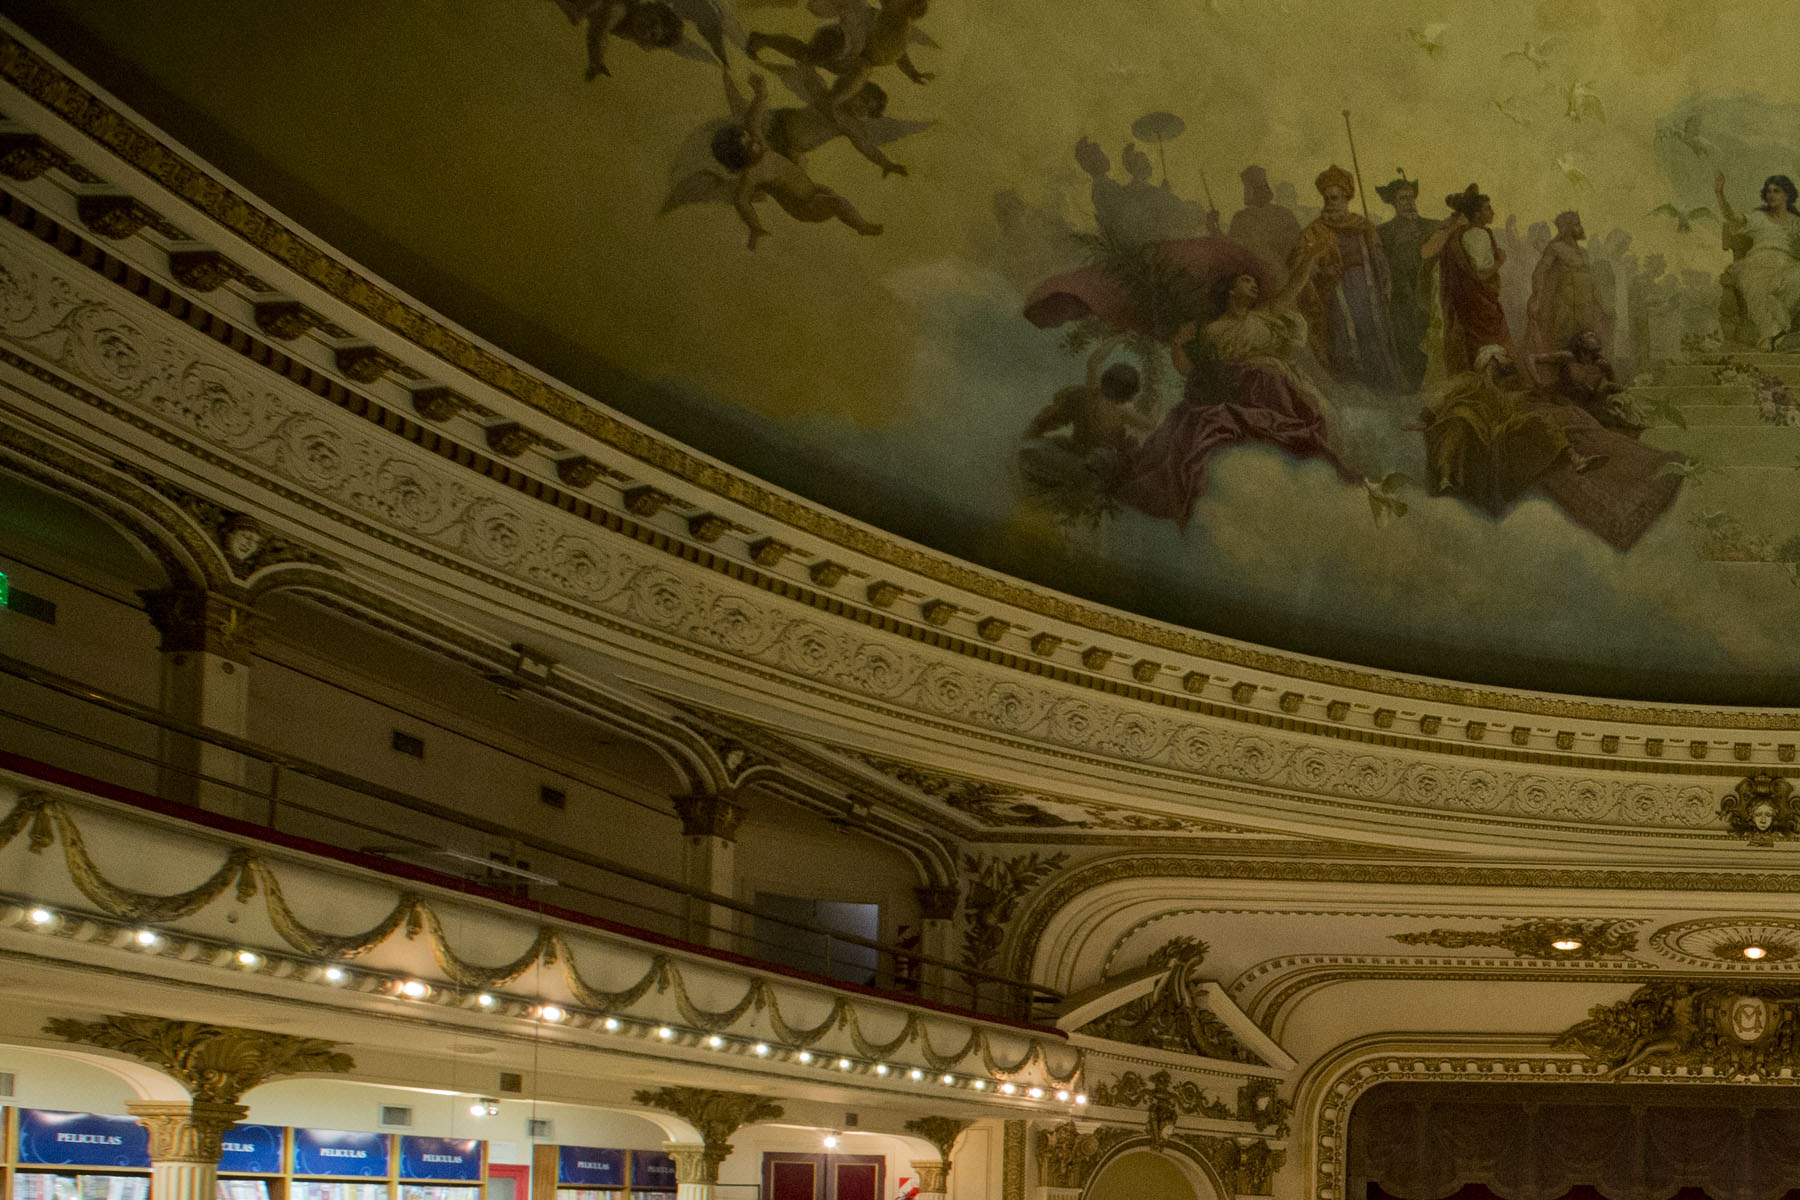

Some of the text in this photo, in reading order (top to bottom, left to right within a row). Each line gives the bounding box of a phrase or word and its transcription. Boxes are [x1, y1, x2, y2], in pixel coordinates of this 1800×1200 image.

[56, 1133, 123, 1146] PELICULAS
[221, 1142, 255, 1153] CULAS
[320, 1147, 367, 1159] PELICULAS
[421, 1153, 463, 1164] PELICULAS
